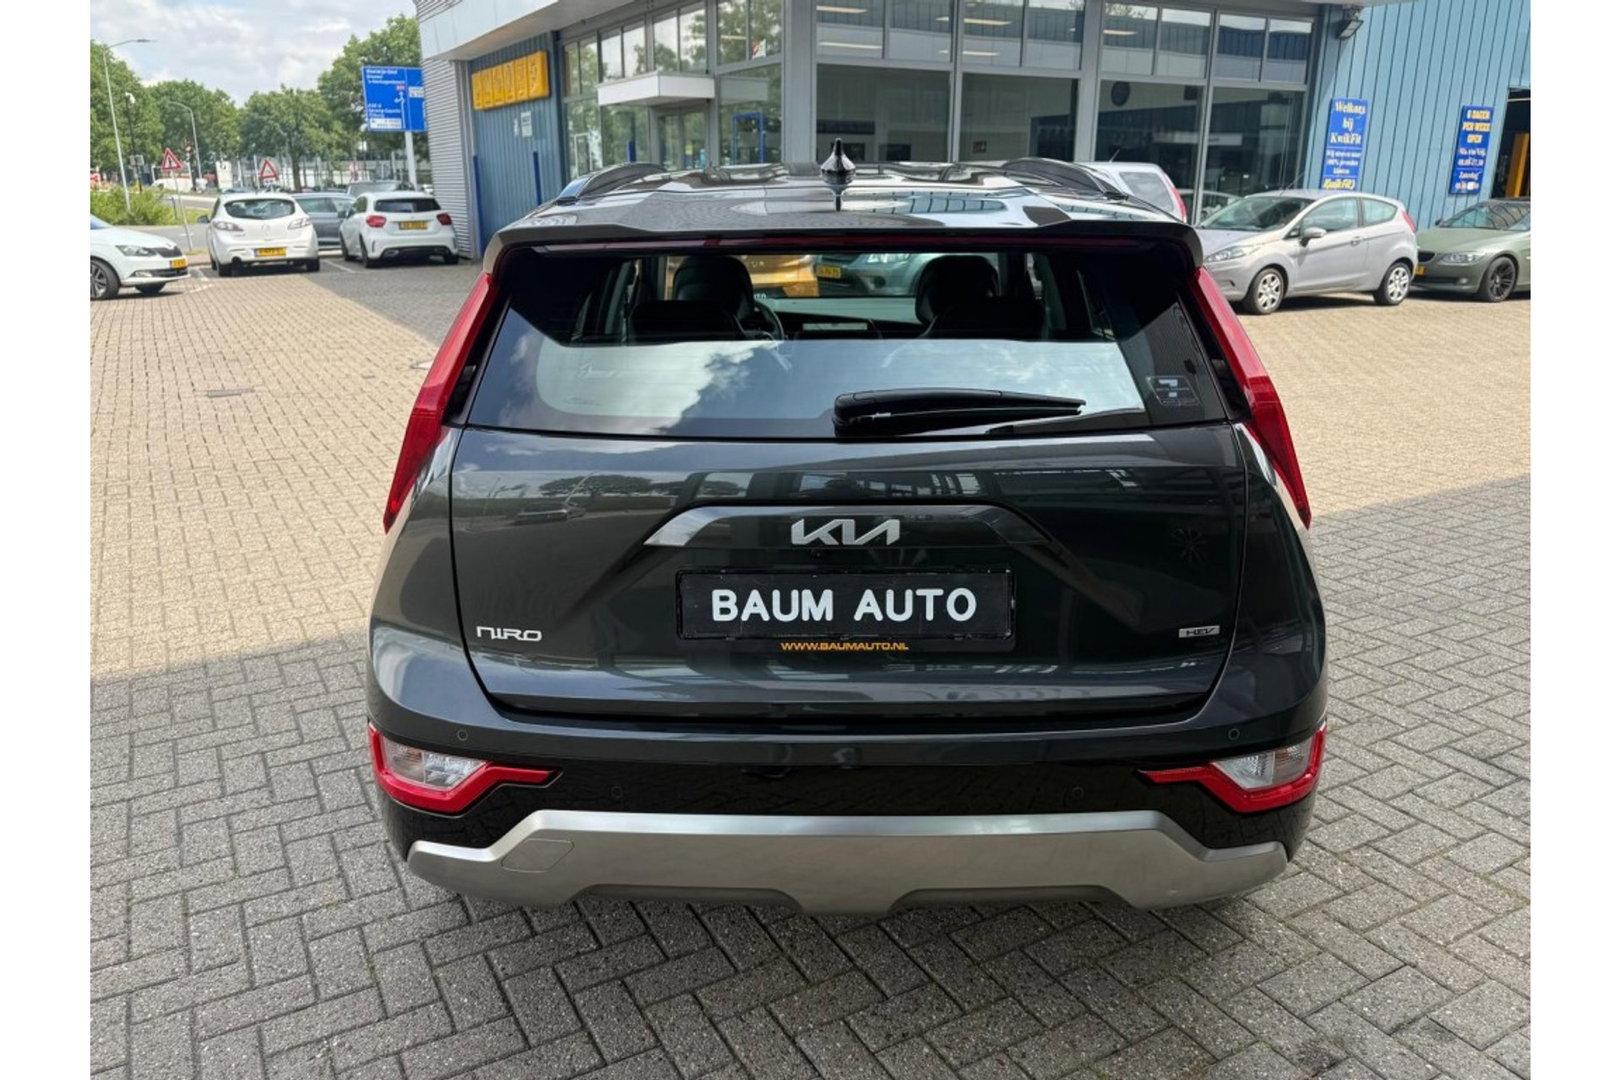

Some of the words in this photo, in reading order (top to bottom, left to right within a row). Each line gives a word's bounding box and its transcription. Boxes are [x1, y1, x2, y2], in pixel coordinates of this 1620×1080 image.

[791, 518, 901, 546] KIA
[711, 589, 834, 622] BAUM
[854, 587, 977, 622] AUTO
[476, 626, 542, 642] NIRO
[780, 642, 910, 651] WWW.BAUMAUTO.NL
